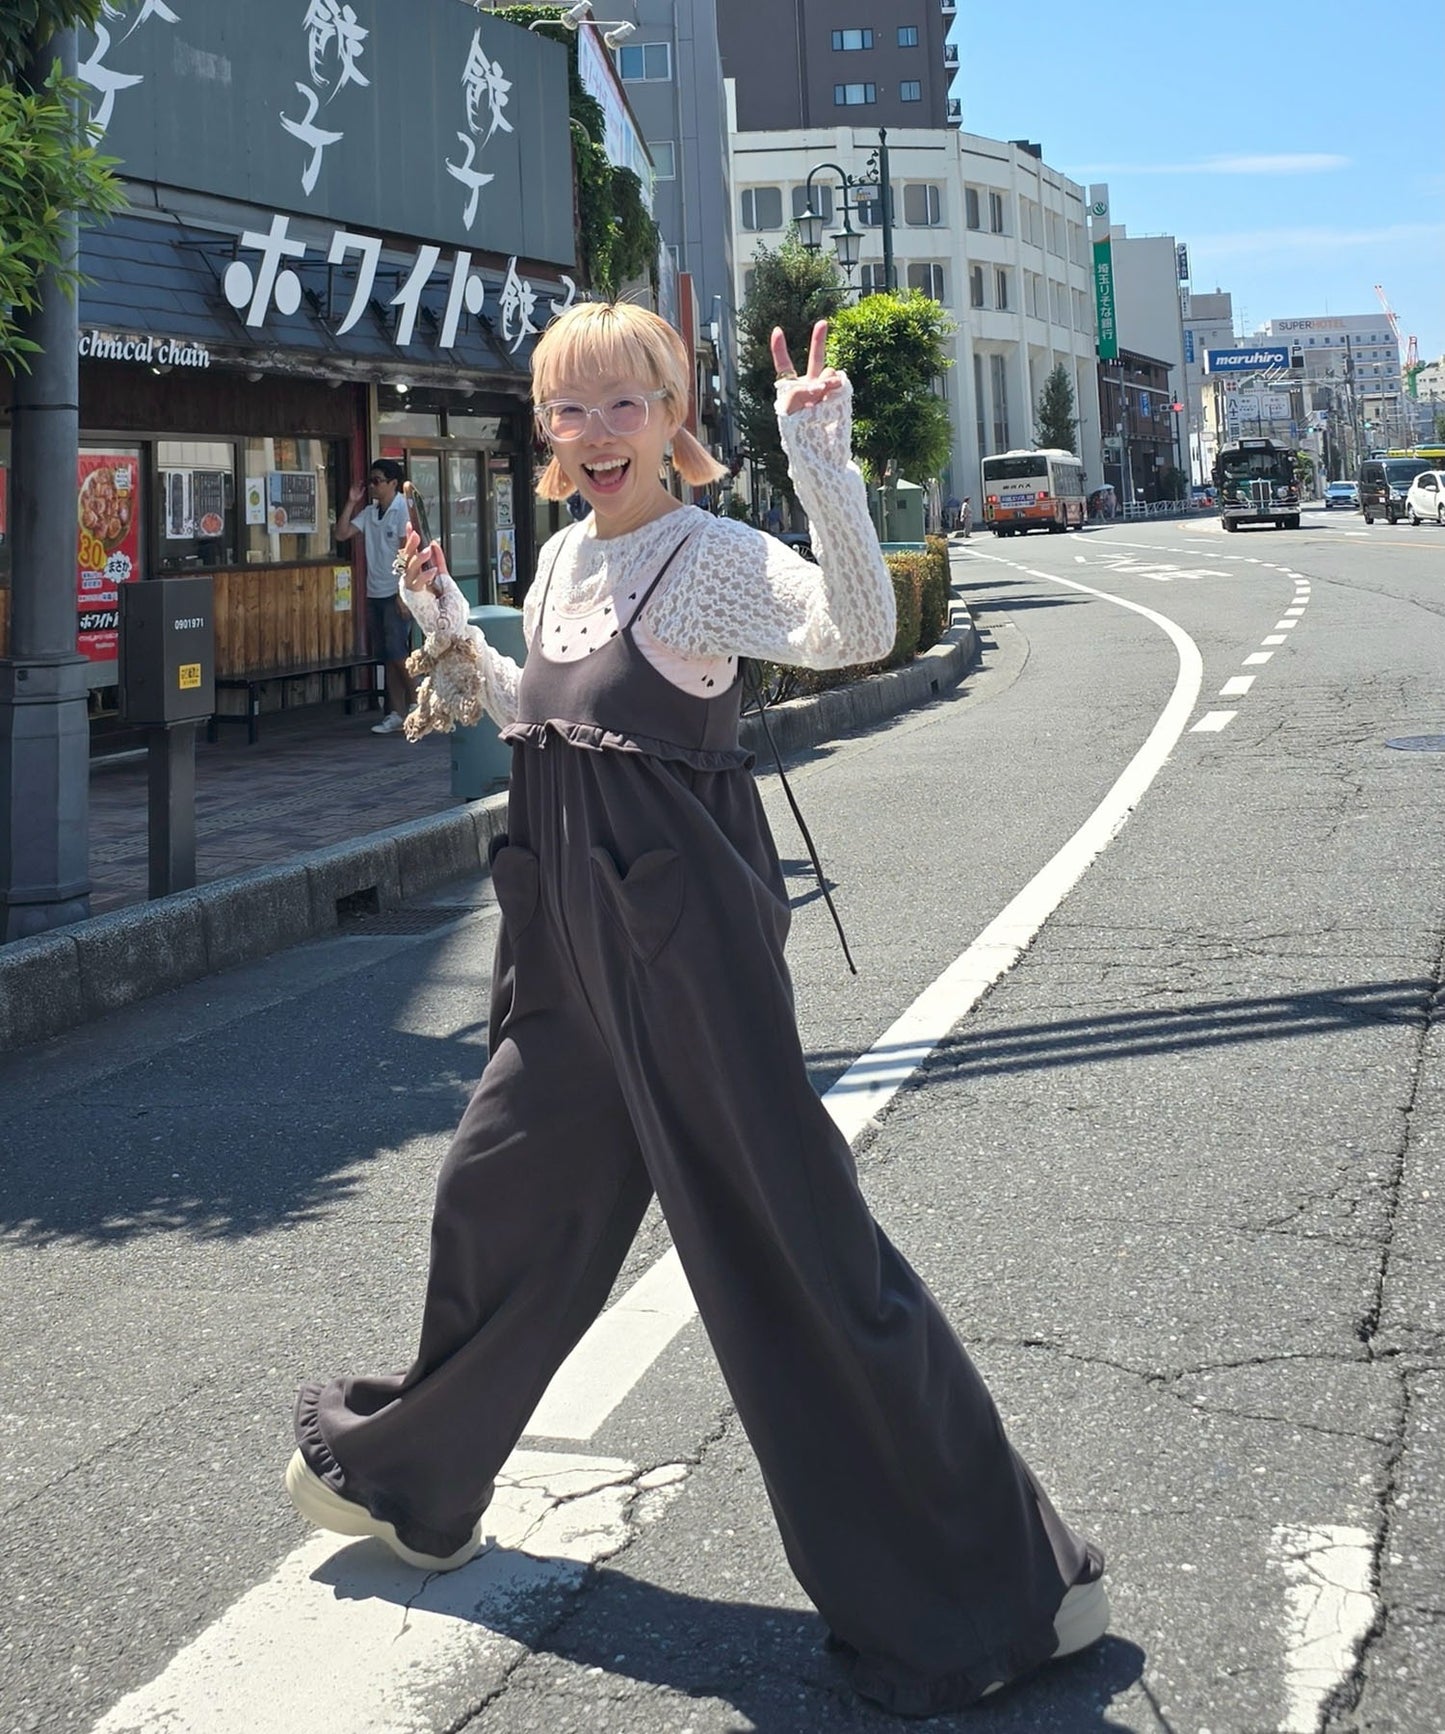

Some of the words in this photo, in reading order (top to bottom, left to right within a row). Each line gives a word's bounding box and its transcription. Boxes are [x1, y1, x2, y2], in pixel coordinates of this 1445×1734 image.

[279, 0, 371, 197] 餃子
[444, 27, 515, 231] 餃子
[1097, 262, 1115, 342] 埼玉りそな銀行
[158, 339, 210, 368] chain
[1215, 352, 1284, 366] maruhiro
[1291, 346, 1302, 356] P
[80, 611, 119, 630] ホワイト
[174, 617, 204, 630] 0901971
